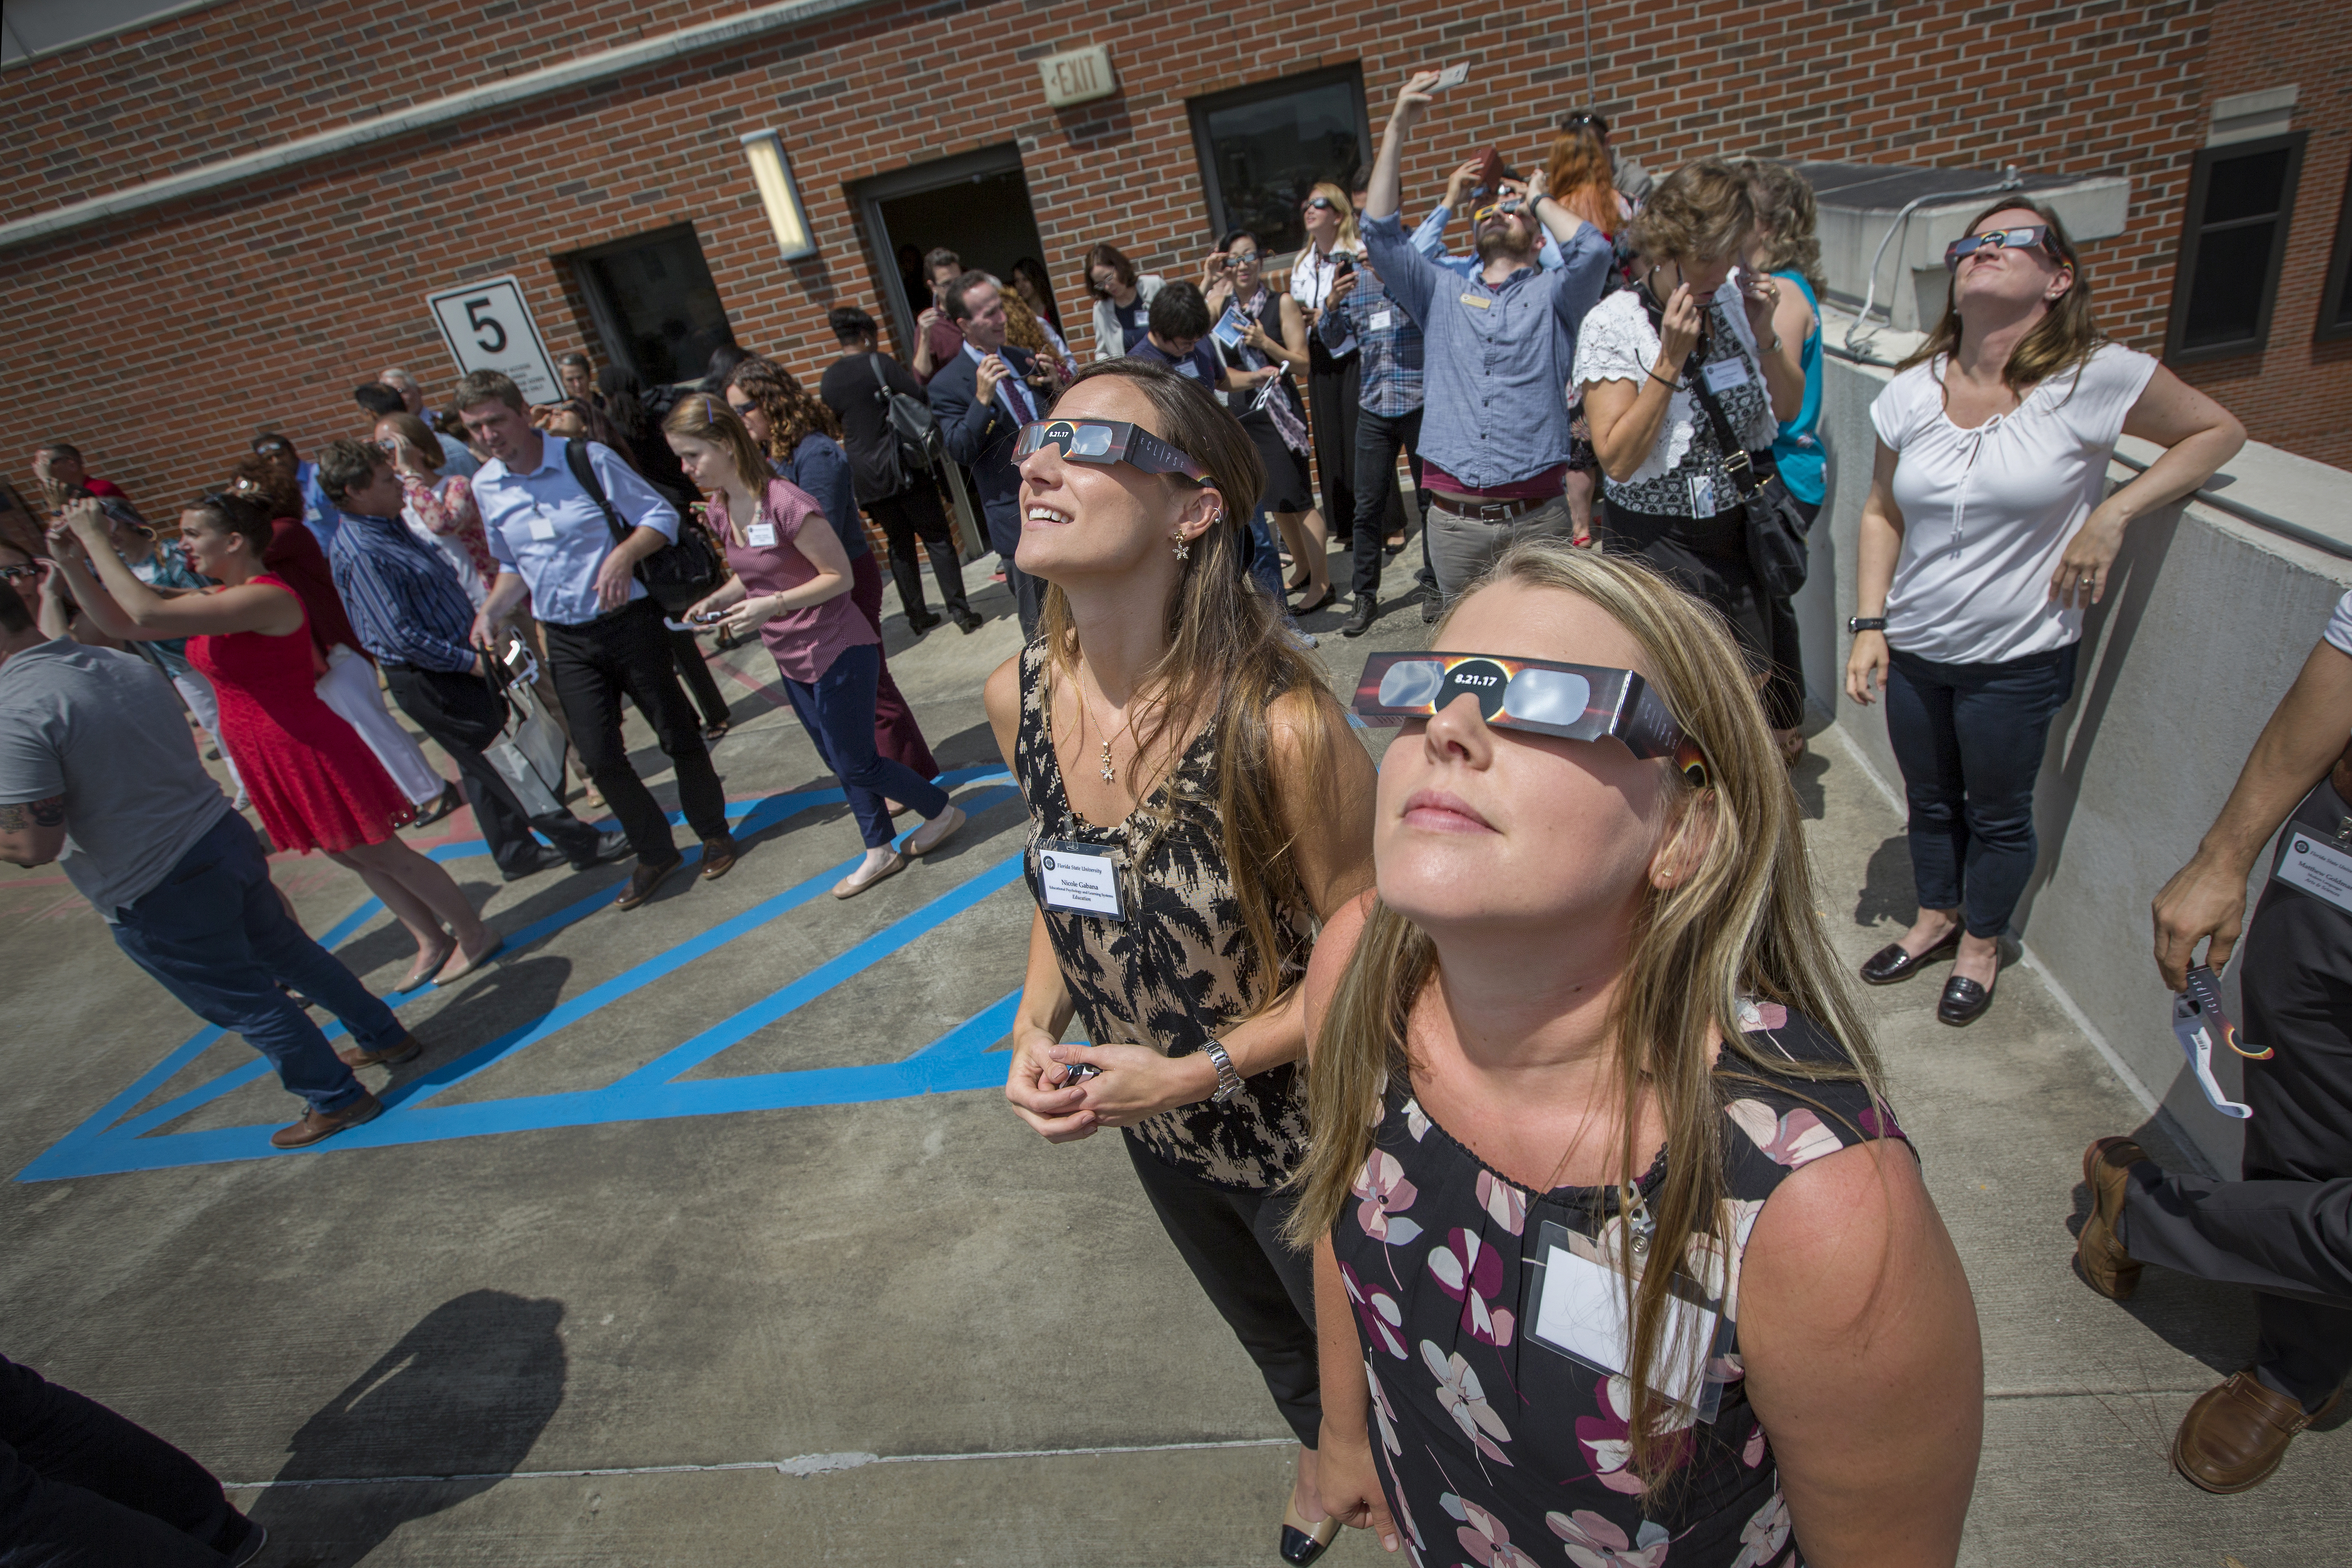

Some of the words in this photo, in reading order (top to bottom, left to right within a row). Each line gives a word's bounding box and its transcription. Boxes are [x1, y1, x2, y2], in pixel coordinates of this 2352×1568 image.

[1056, 56, 1097, 96] EXIT
[464, 296, 506, 353] 5
[1140, 438, 1184, 468] ECLIPSE
[1454, 673, 1498, 687] 8.21.17
[1642, 697, 1677, 750] ECLIPSE
[2310, 851, 2326, 860] Florida
[1082, 866, 1102, 875] University
[2298, 861, 2325, 876] Matthew
[2321, 885, 2340, 897] Sciences
[2322, 880, 2343, 891] Languages
[2189, 976, 2219, 1013] ECLIPSE
